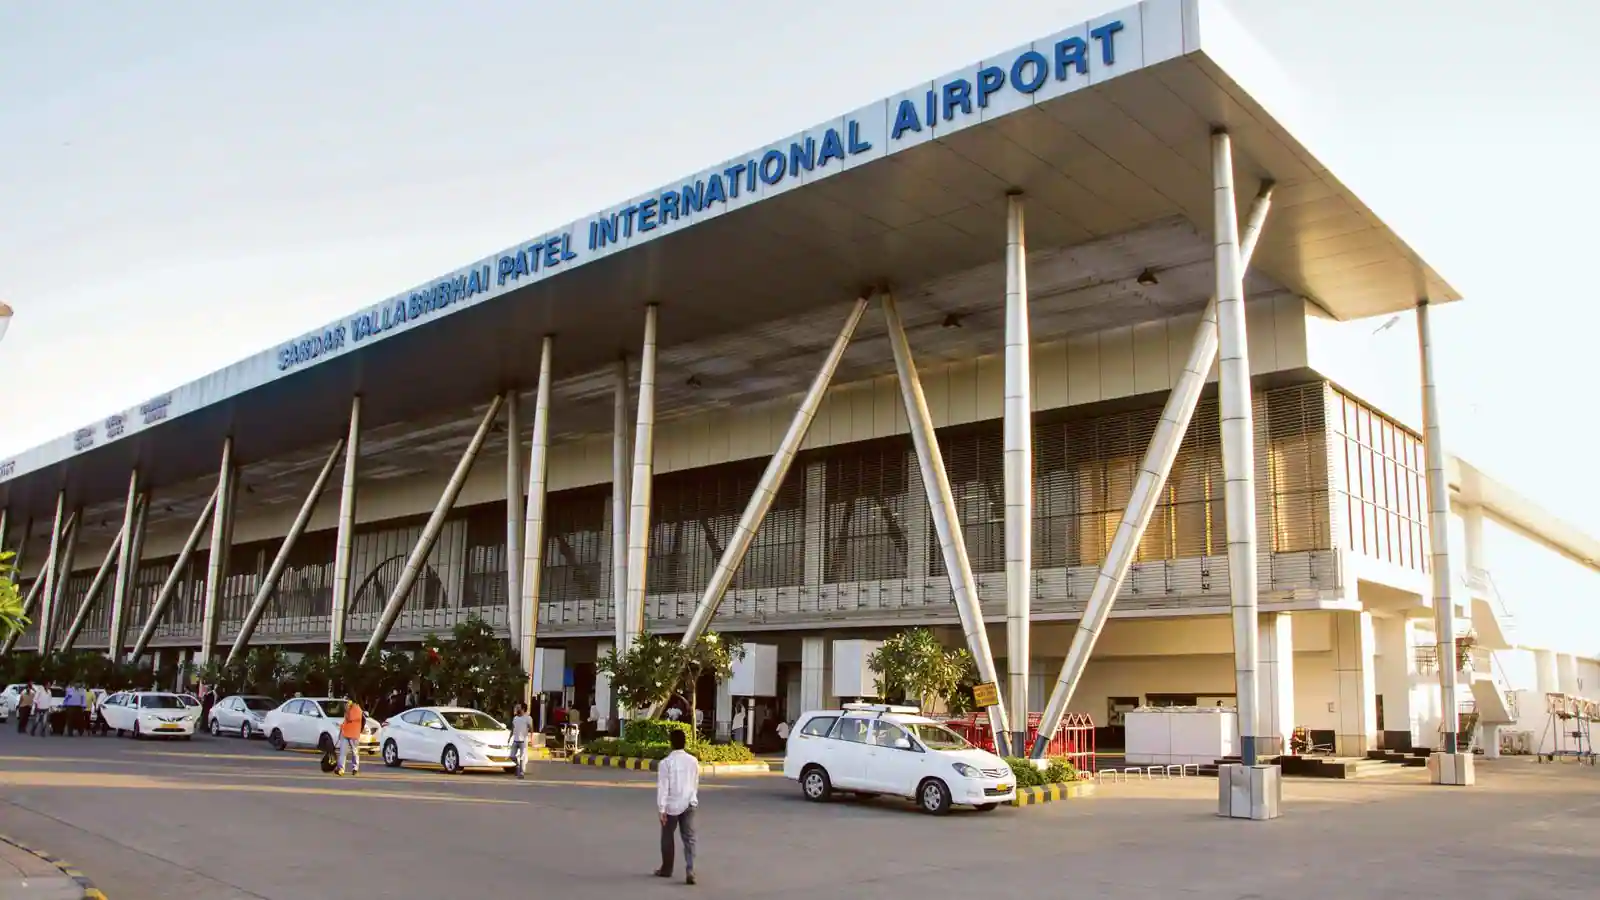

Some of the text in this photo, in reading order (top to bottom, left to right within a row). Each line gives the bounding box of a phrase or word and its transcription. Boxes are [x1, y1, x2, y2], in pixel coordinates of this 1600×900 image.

[497, 232, 577, 286] PATEL
[589, 120, 871, 250] INTERNATIONAL
[891, 20, 1124, 139] AIRPORT
